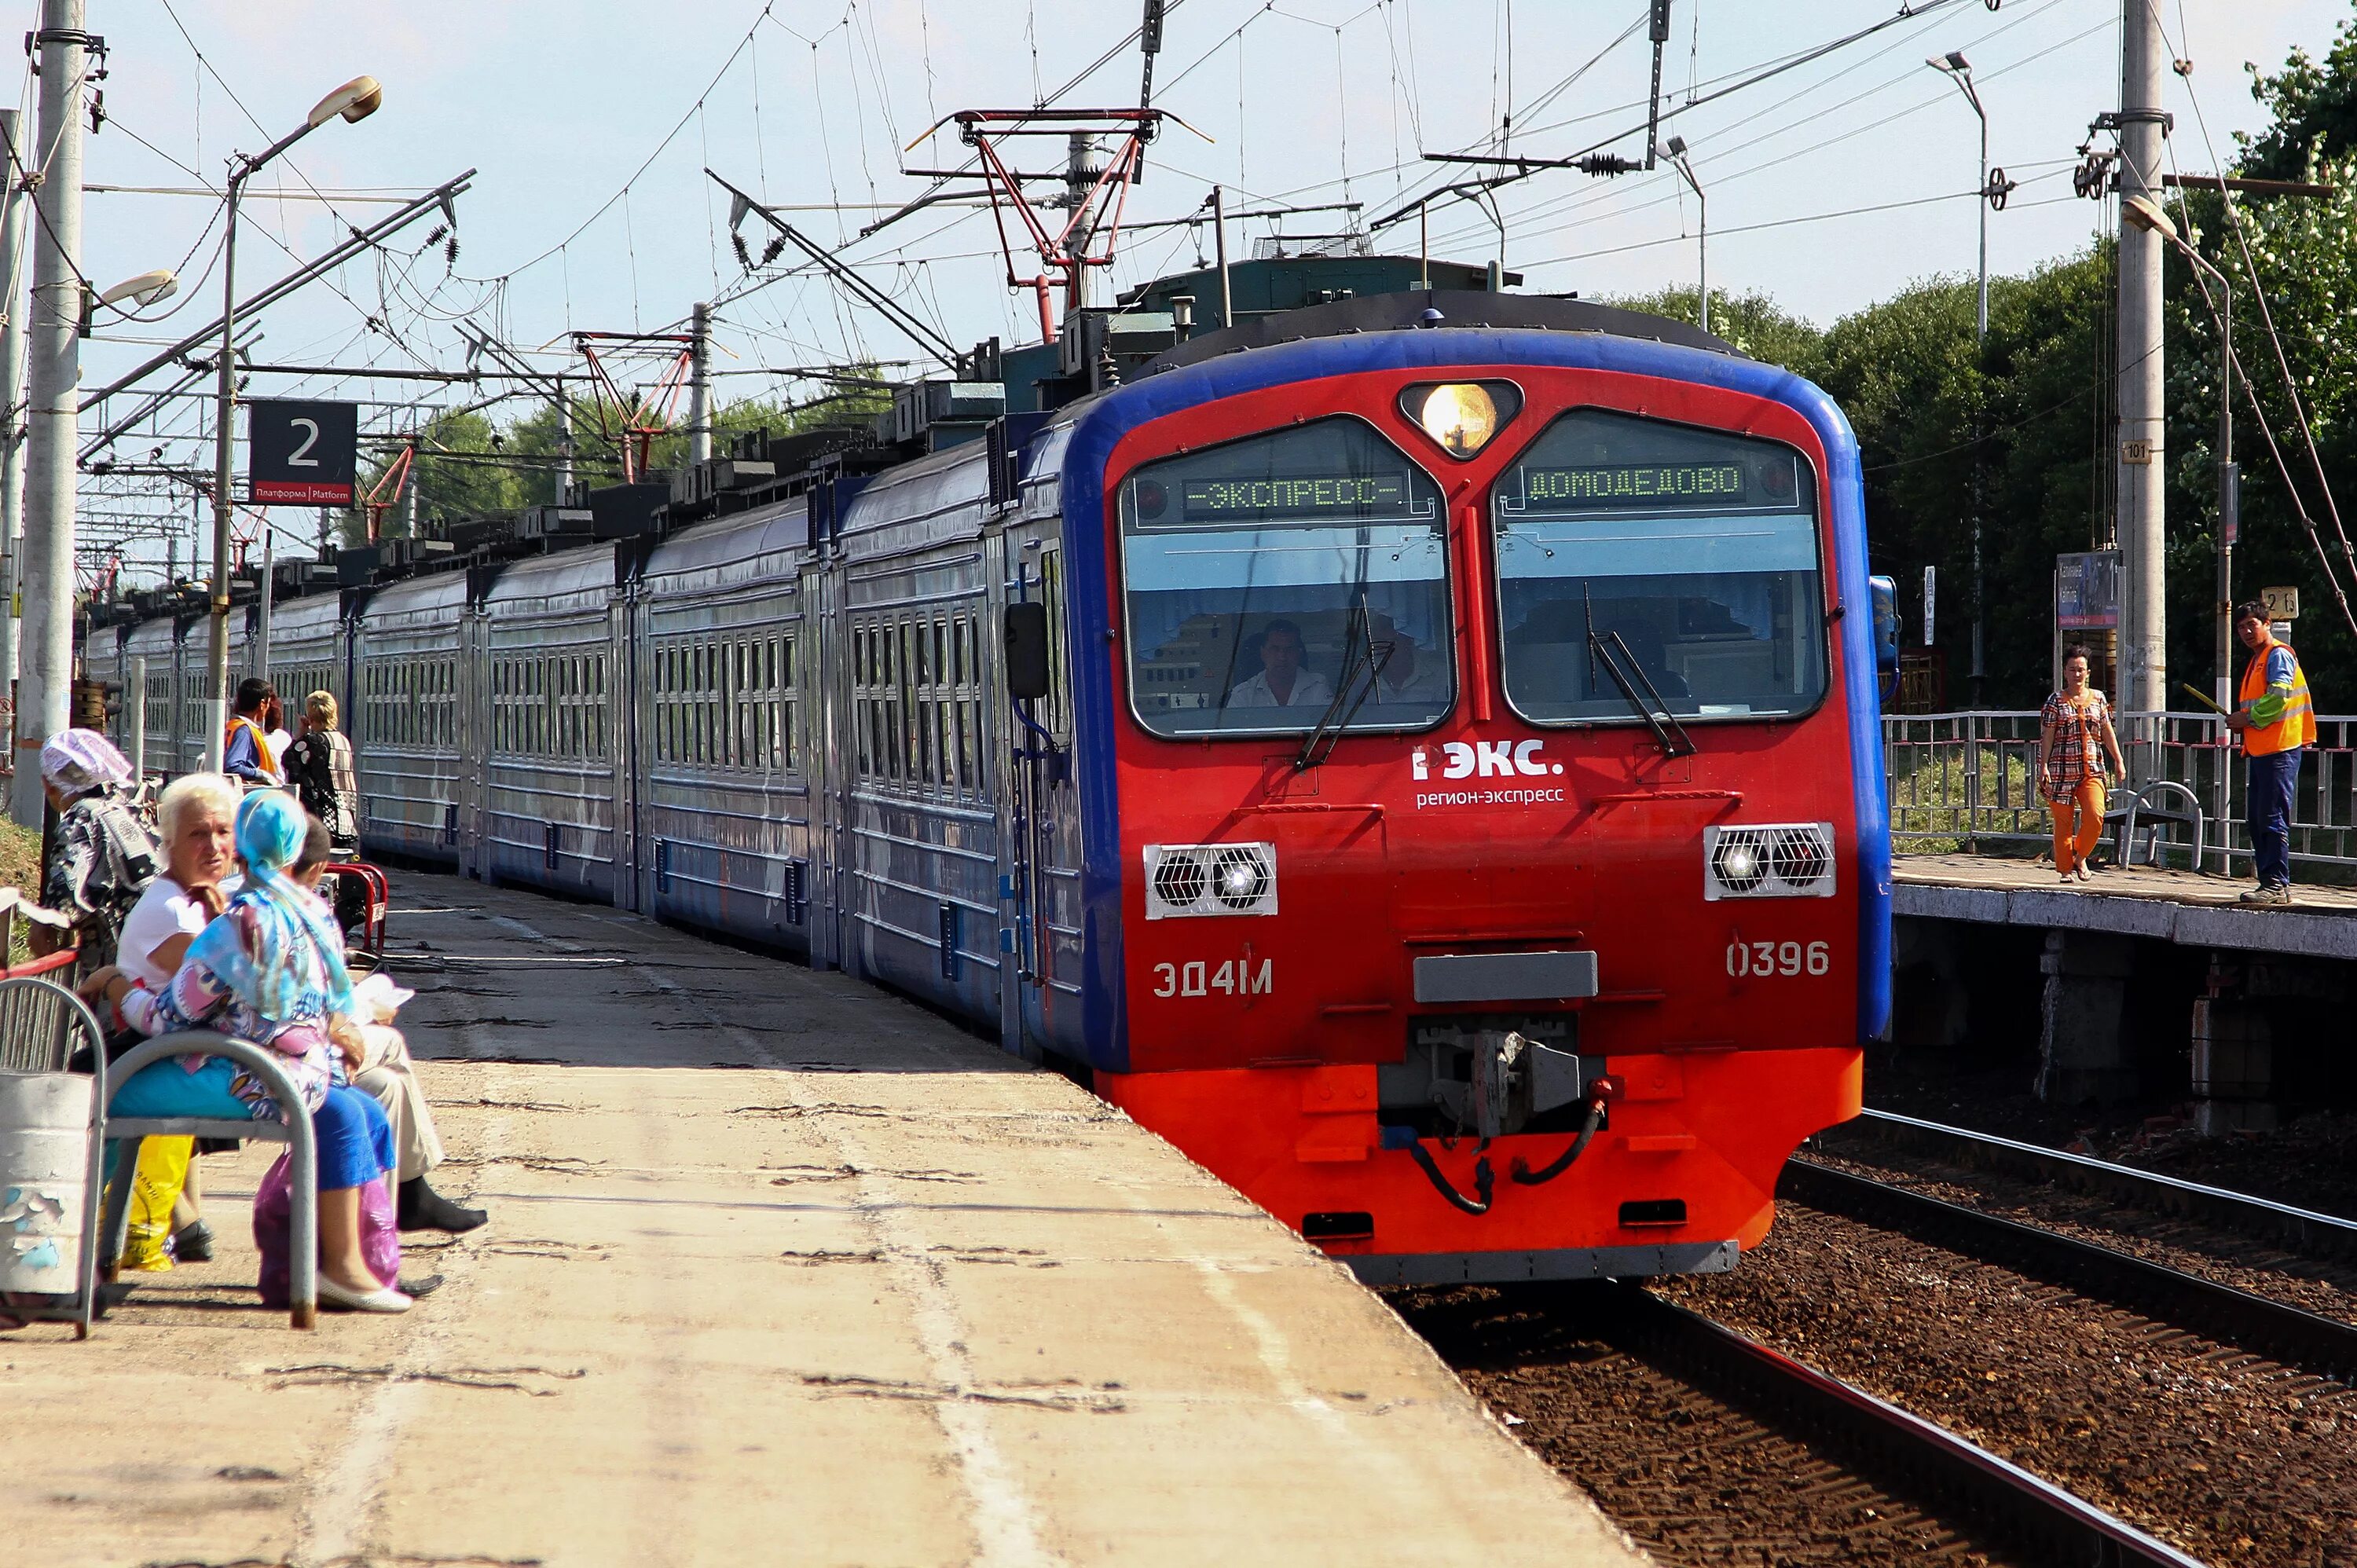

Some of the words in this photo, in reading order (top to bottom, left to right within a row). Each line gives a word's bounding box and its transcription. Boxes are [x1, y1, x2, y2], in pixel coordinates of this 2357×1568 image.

[288, 418, 319, 467] 2
[2128, 444, 2146, 458] 101
[256, 488, 306, 497] Платформа
[313, 489, 348, 500] Platform
[1530, 467, 1739, 499] ДОМОДЕДОВО
[1417, 788, 1564, 810] регион-экспресс
[1727, 941, 1830, 977] 0396
[1153, 958, 1273, 998] ЭД4М
